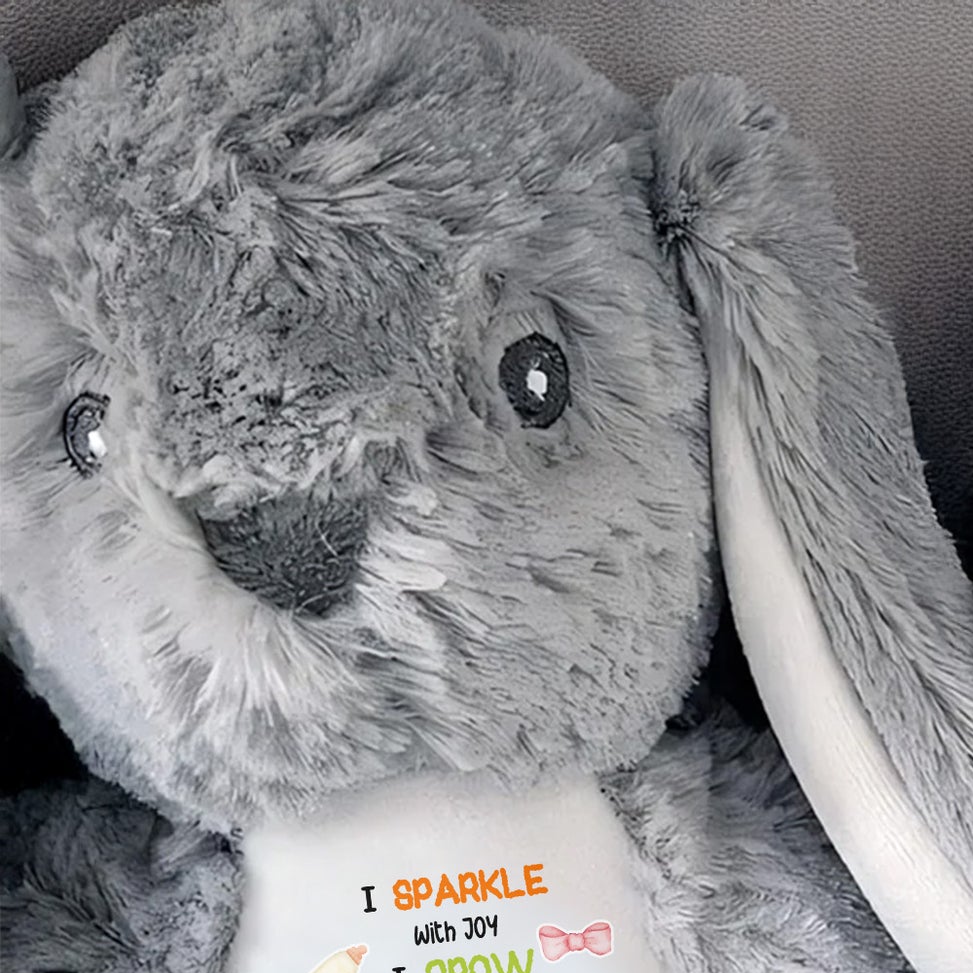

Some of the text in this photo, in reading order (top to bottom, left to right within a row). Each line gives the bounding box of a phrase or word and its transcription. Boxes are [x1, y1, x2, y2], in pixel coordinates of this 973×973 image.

[361, 864, 549, 913] I SPARKLE
[462, 915, 497, 939] JOY
